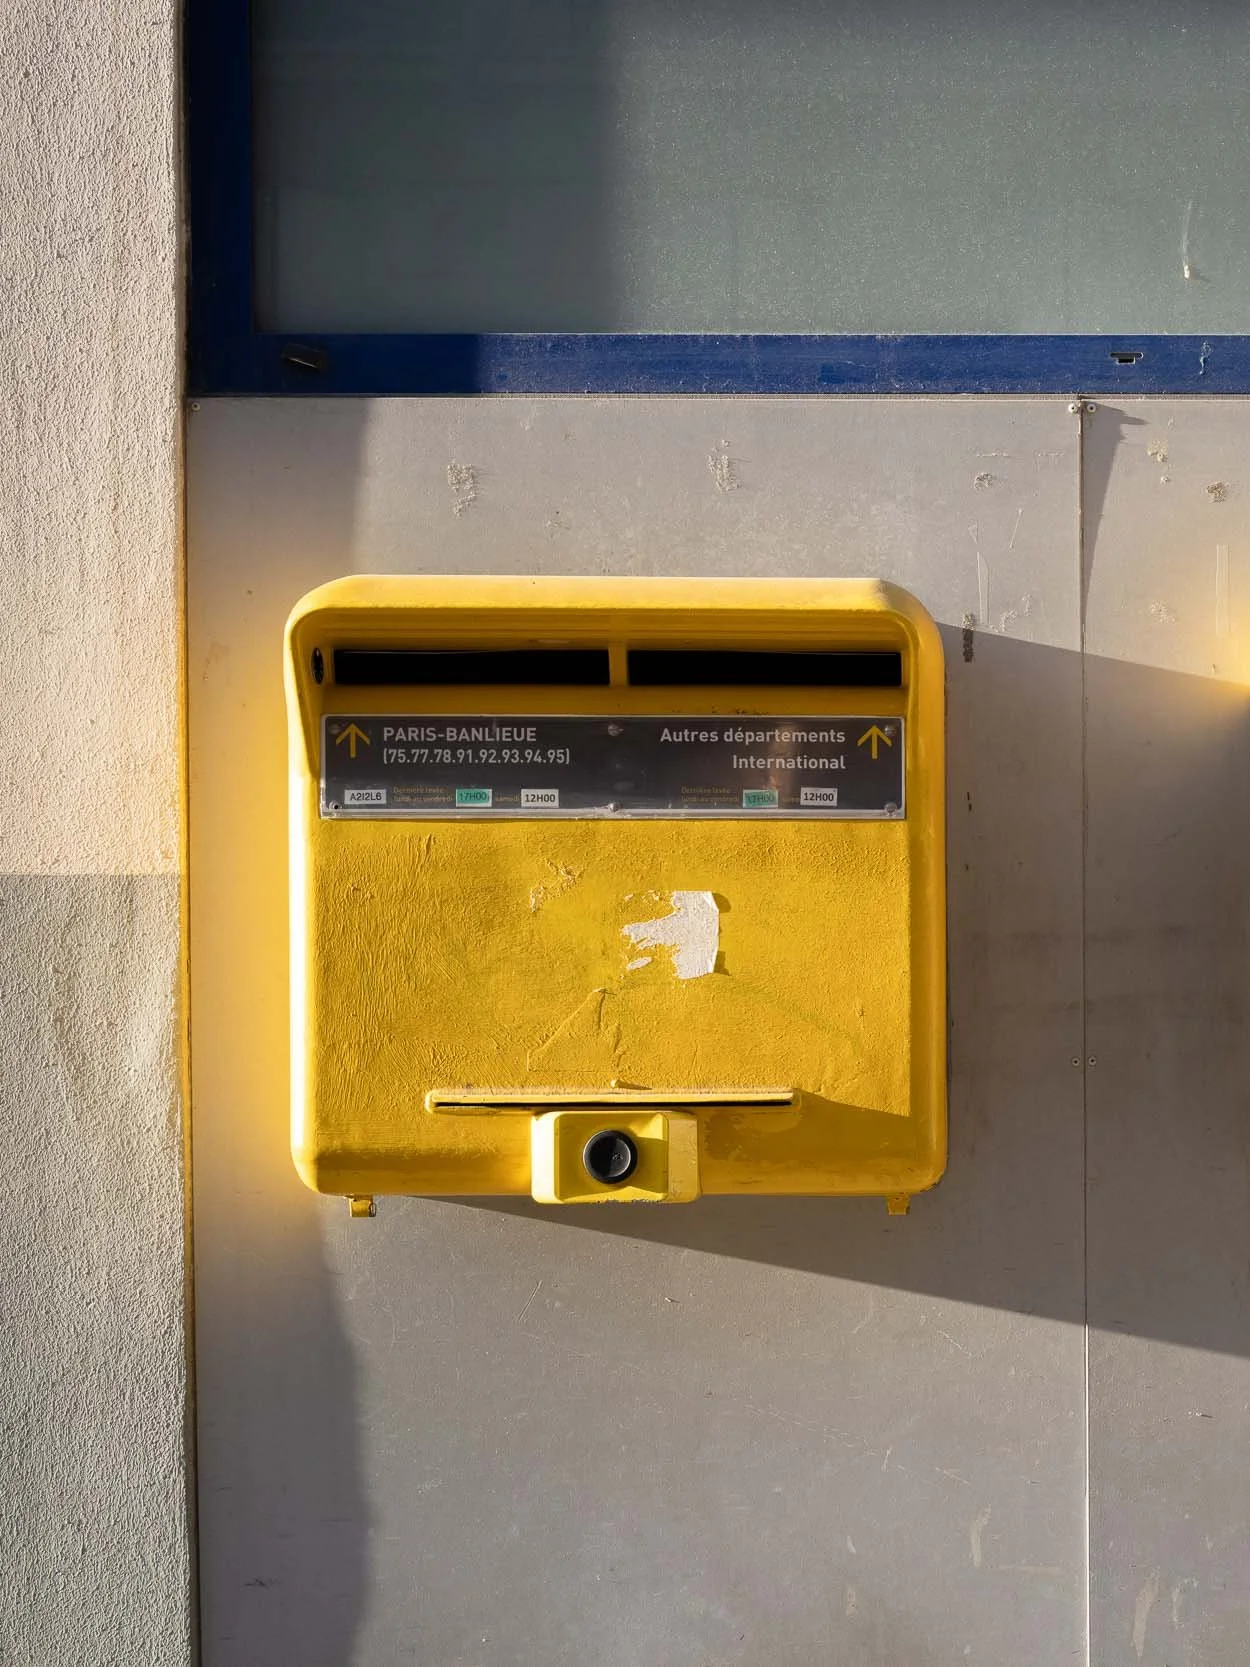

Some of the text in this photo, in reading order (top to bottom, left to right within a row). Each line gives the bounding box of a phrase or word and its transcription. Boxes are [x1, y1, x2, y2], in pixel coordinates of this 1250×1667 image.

[383, 727, 537, 742] PARIS-BANLIEUE
[660, 727, 846, 746] Autres départements
[733, 755, 846, 769] International
[525, 793, 556, 803] 12H00
[803, 791, 835, 802] 12H00
